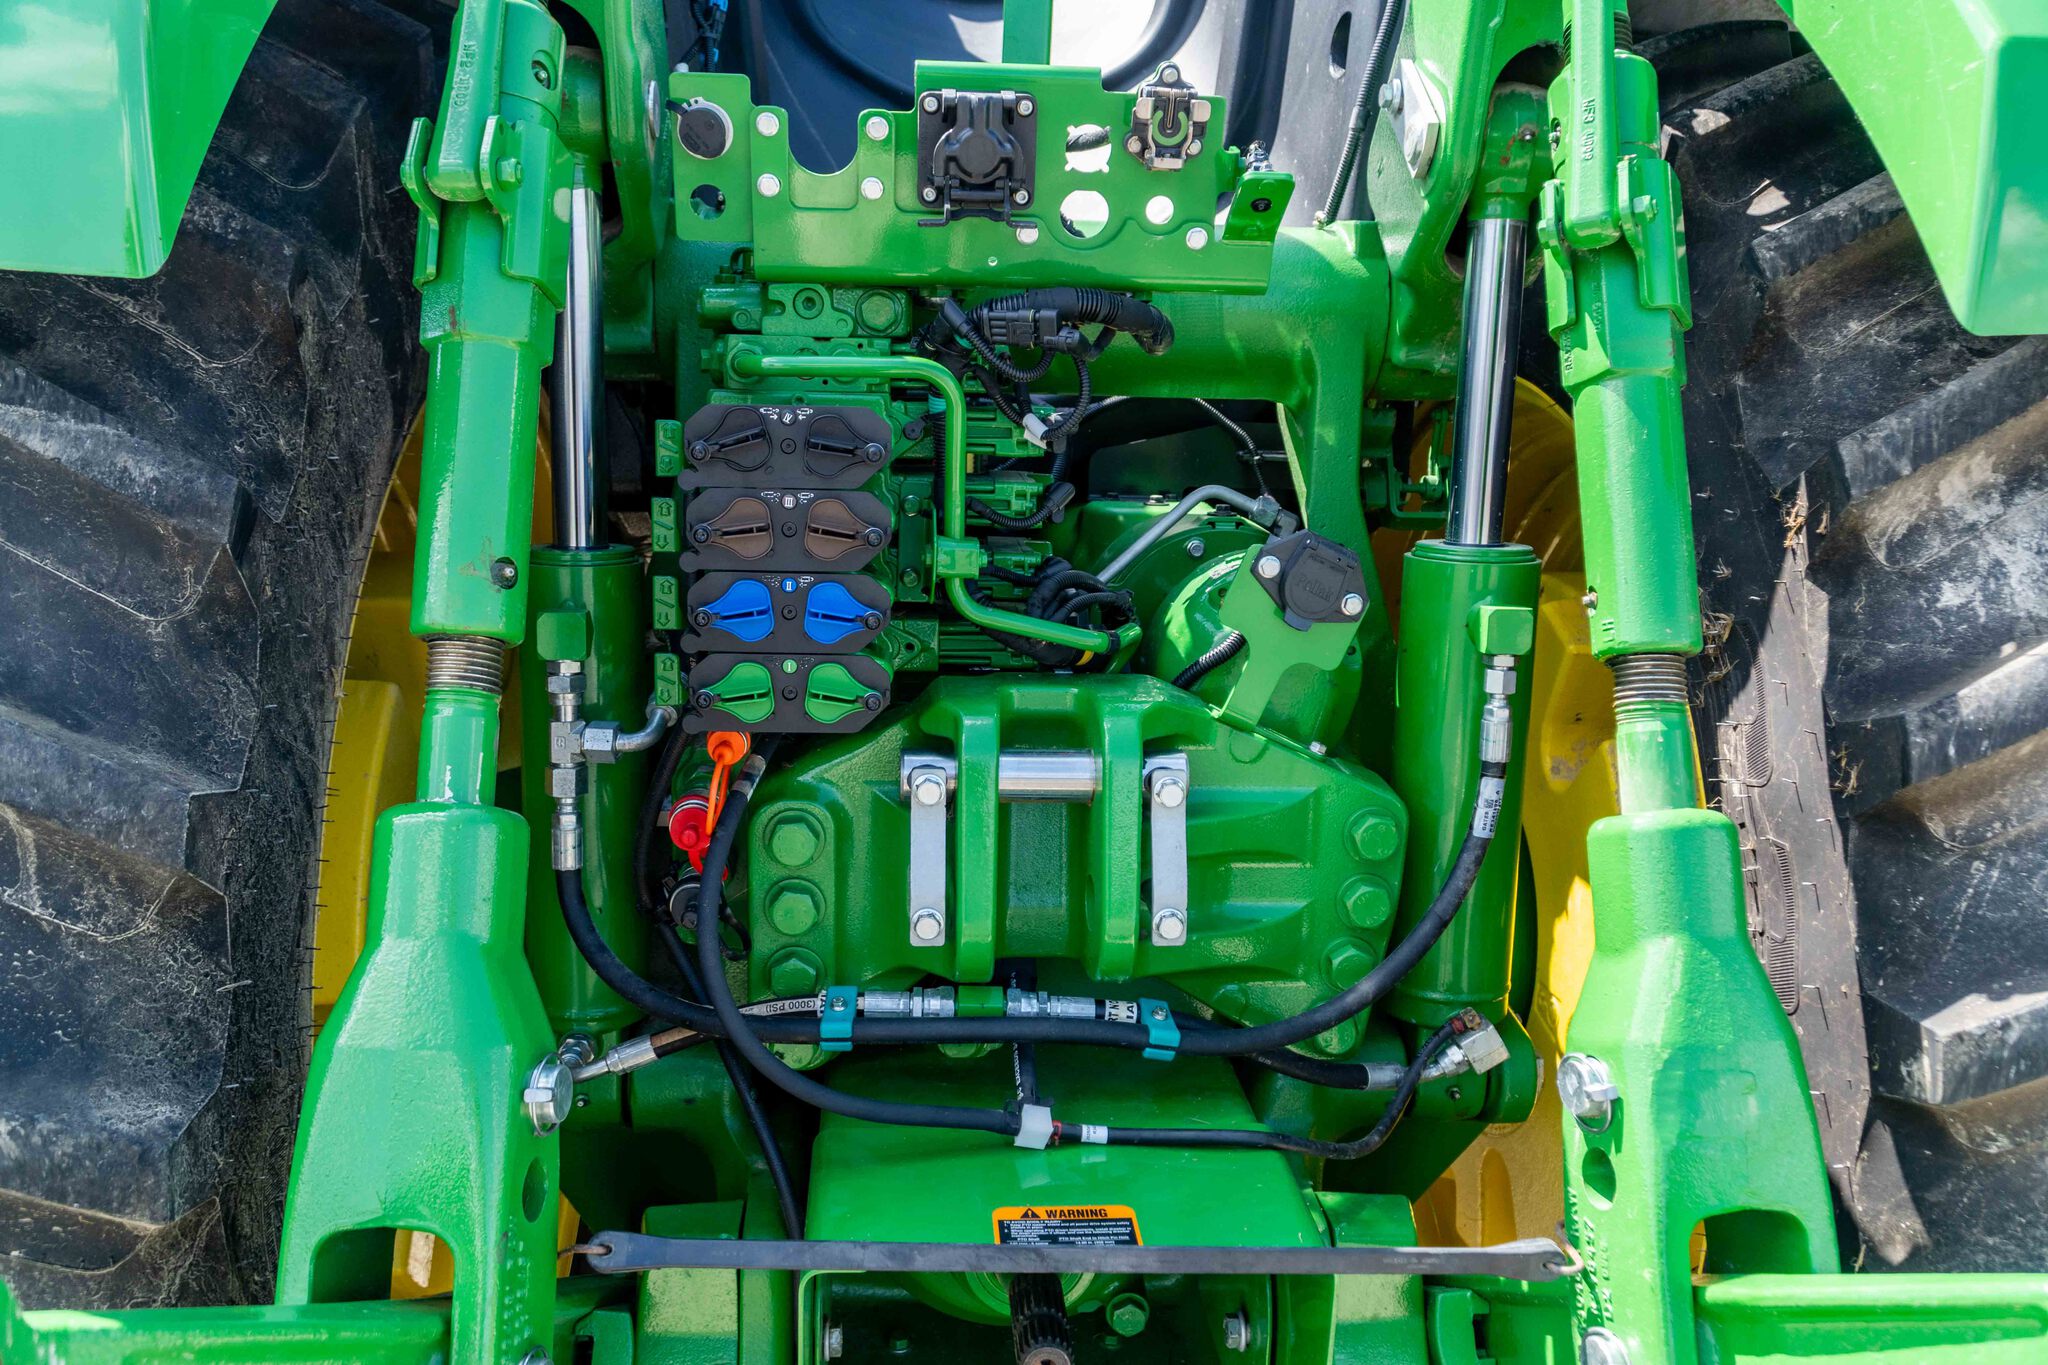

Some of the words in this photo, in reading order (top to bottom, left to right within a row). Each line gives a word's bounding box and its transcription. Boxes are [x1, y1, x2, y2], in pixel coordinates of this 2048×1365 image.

[766, 1003, 785, 1014] PSI)
[788, 1000, 816, 1010] (3000
[1045, 1208, 1109, 1219] WARNING
